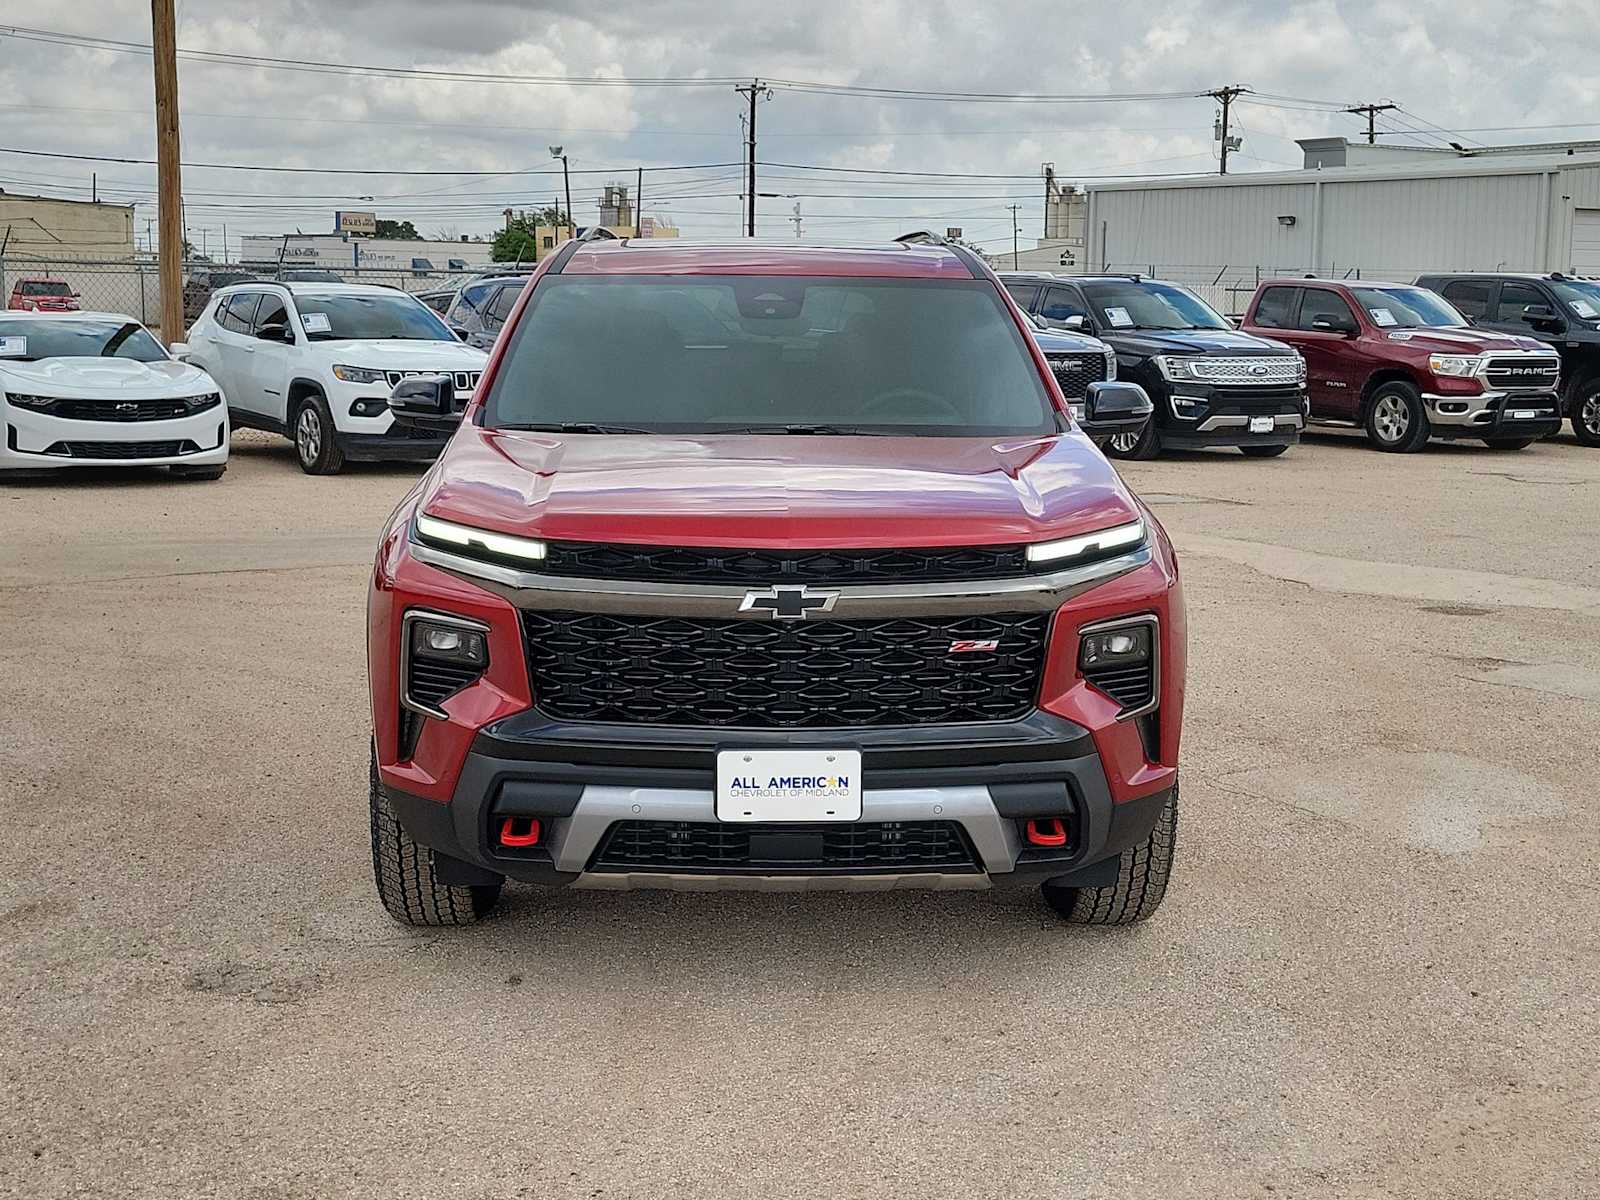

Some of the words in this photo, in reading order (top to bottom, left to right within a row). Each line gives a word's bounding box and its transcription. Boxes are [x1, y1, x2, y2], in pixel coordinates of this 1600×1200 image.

[948, 640, 999, 652] Z71
[731, 777, 760, 789] ALL
[730, 789, 787, 798] CHEVROLET
[789, 789, 803, 797] OF
[805, 788, 849, 797] MIDLAND
